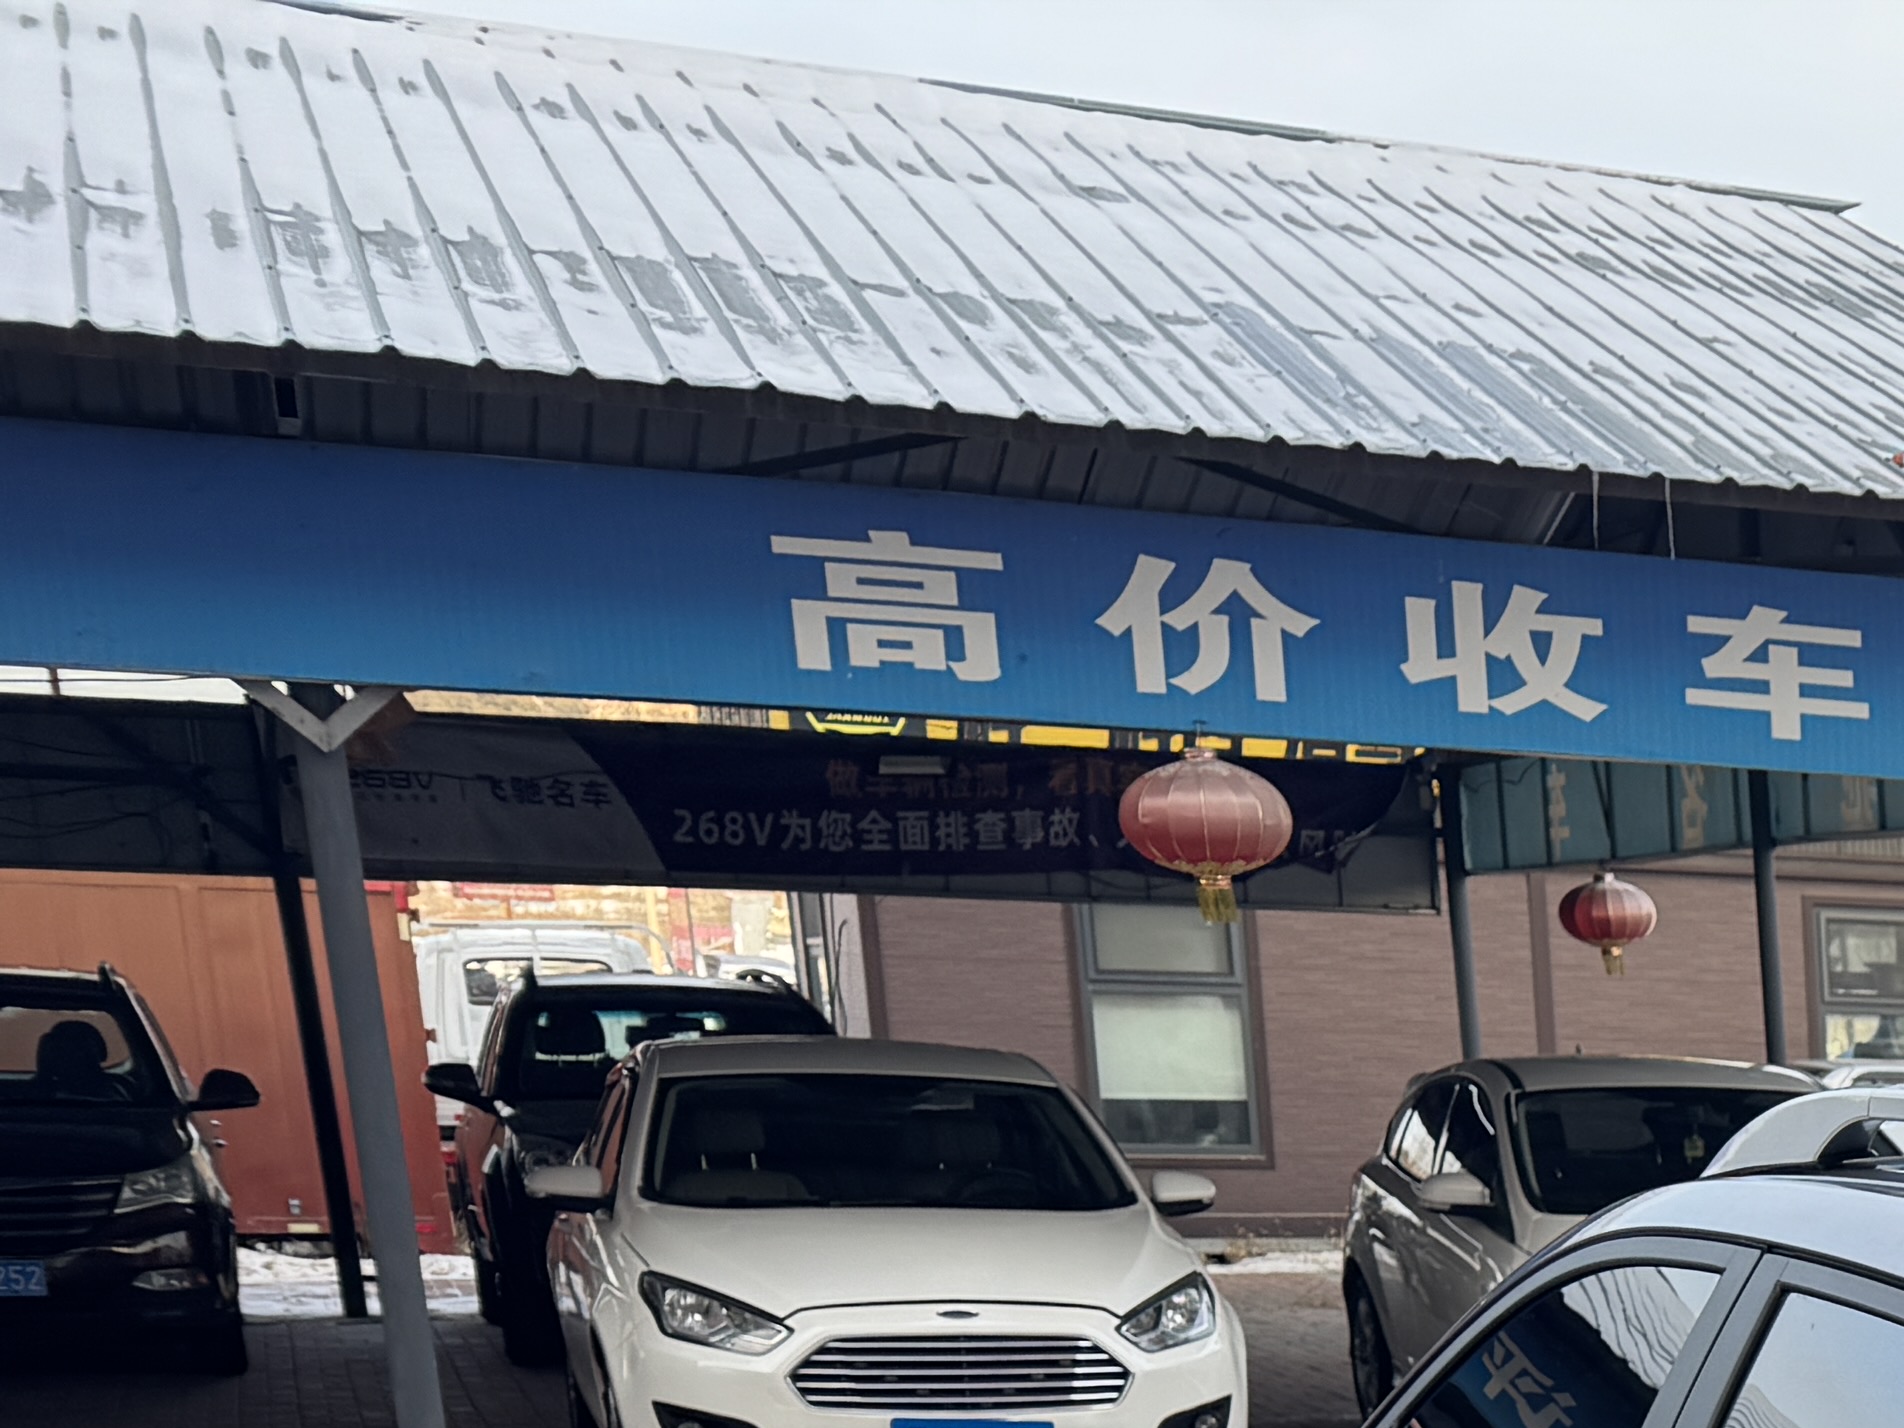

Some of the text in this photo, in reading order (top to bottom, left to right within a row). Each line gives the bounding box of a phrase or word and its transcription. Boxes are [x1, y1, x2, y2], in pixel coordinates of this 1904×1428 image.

[770, 529, 1870, 741] 高价收车
[475, 773, 612, 809] 飞驰名车
